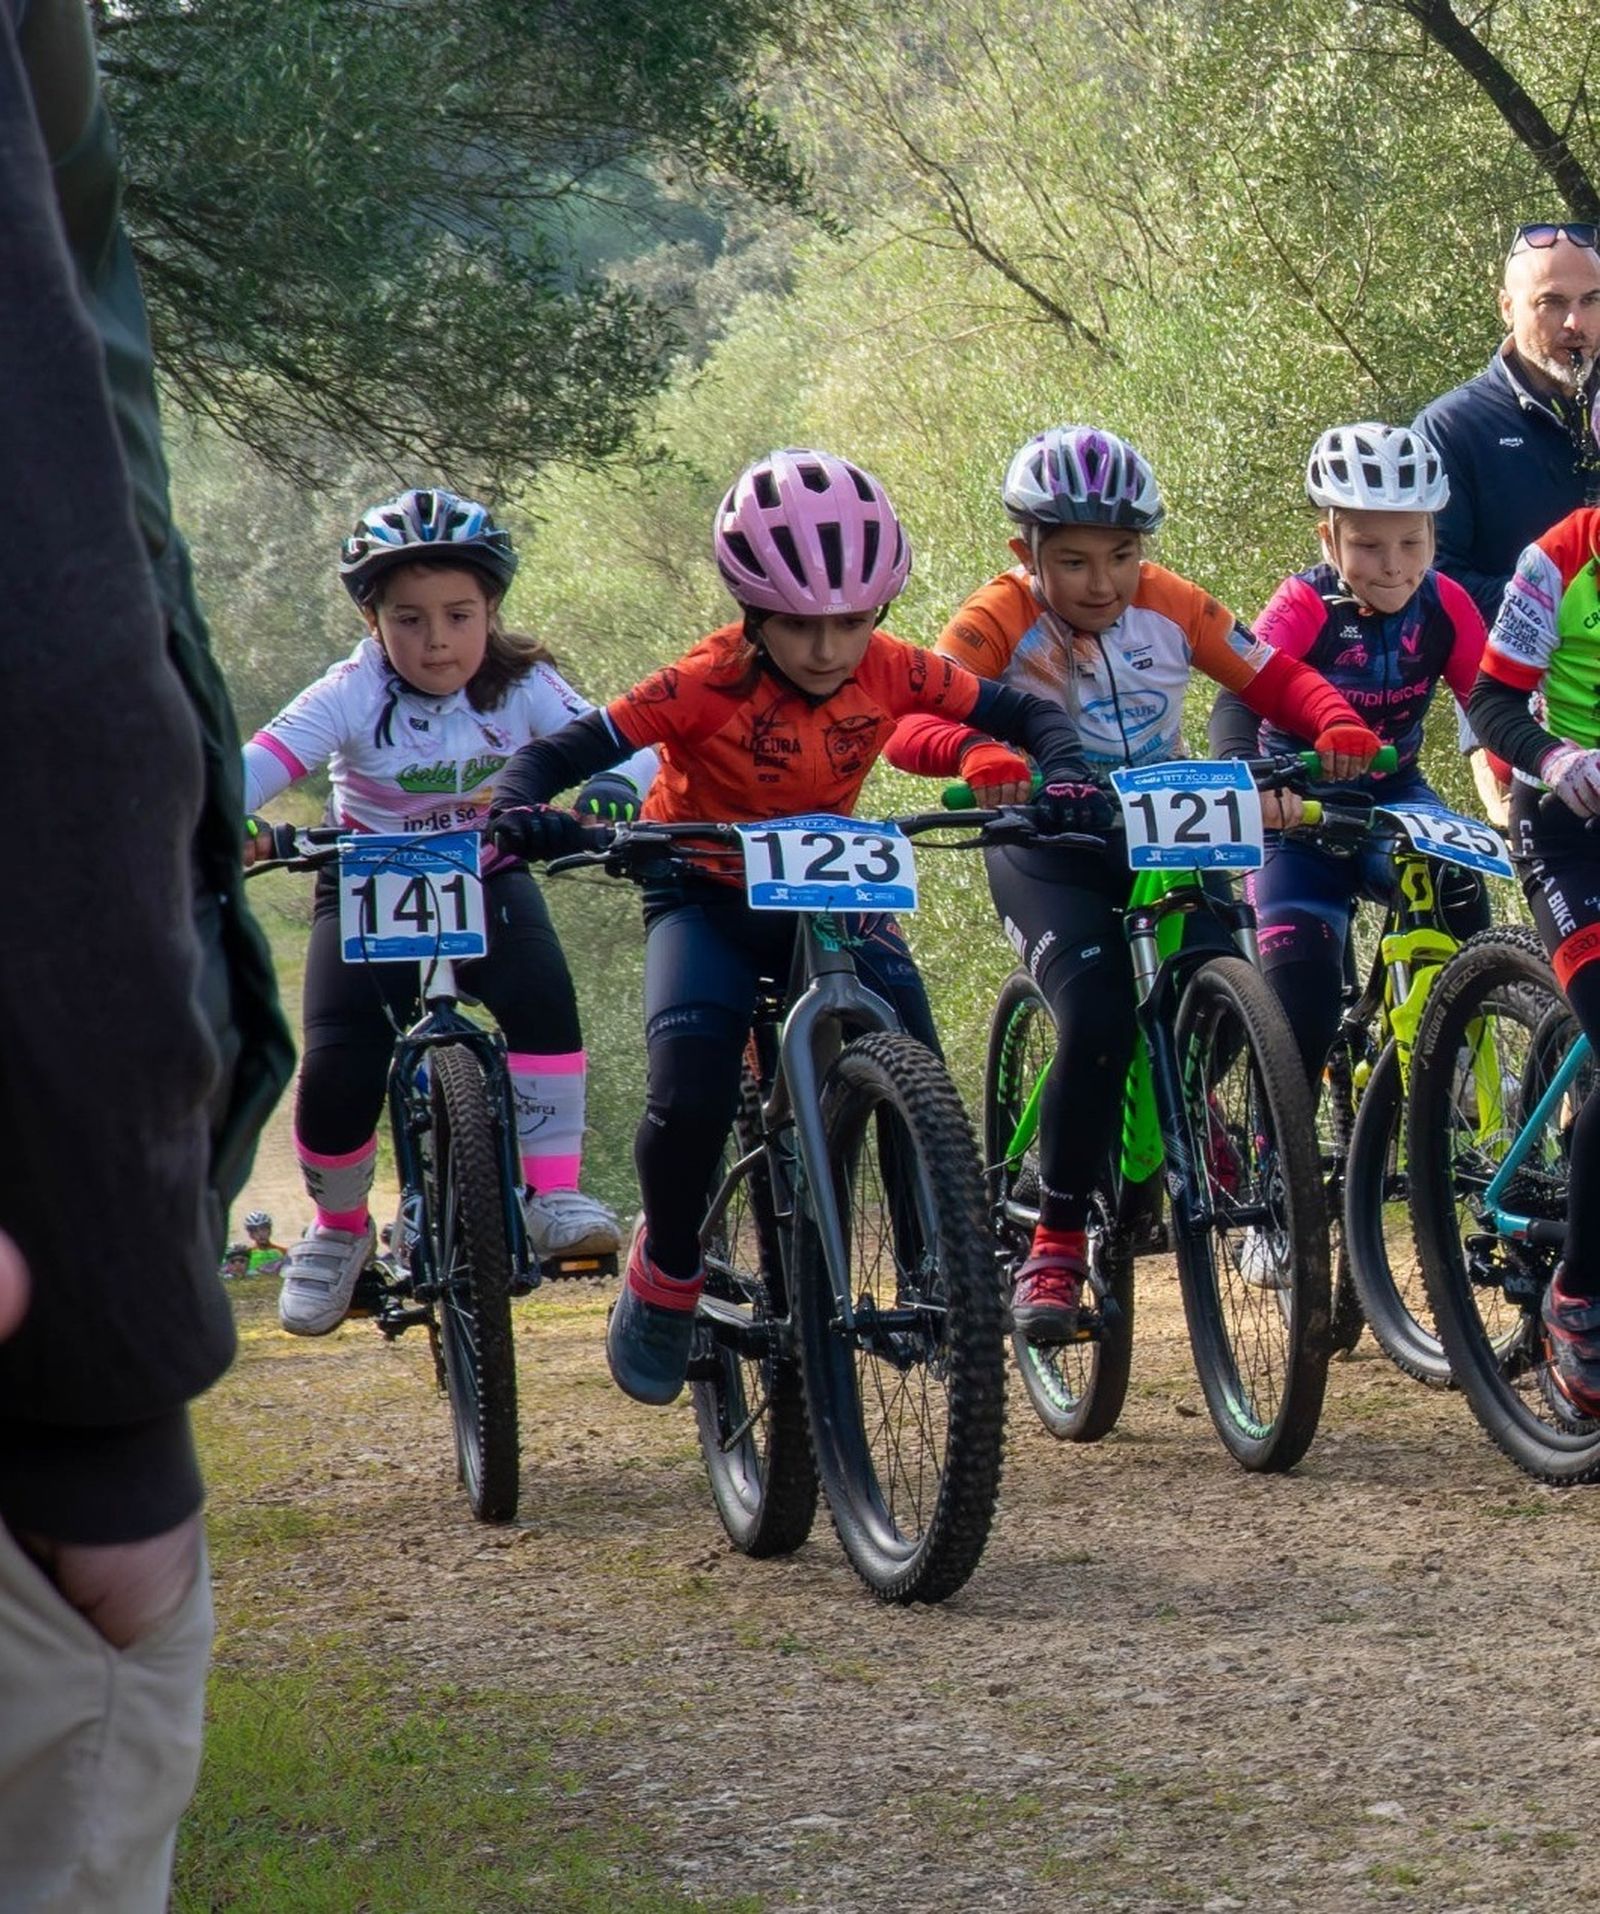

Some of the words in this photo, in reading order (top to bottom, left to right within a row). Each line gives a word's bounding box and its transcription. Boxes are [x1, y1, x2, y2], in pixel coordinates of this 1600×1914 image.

[1185, 773, 1208, 781] XCO
[1129, 790, 1241, 843] 121
[1401, 814, 1498, 857] 125
[751, 832, 900, 883] 123
[352, 875, 467, 933] 141
[1548, 891, 1577, 937] BIKE
